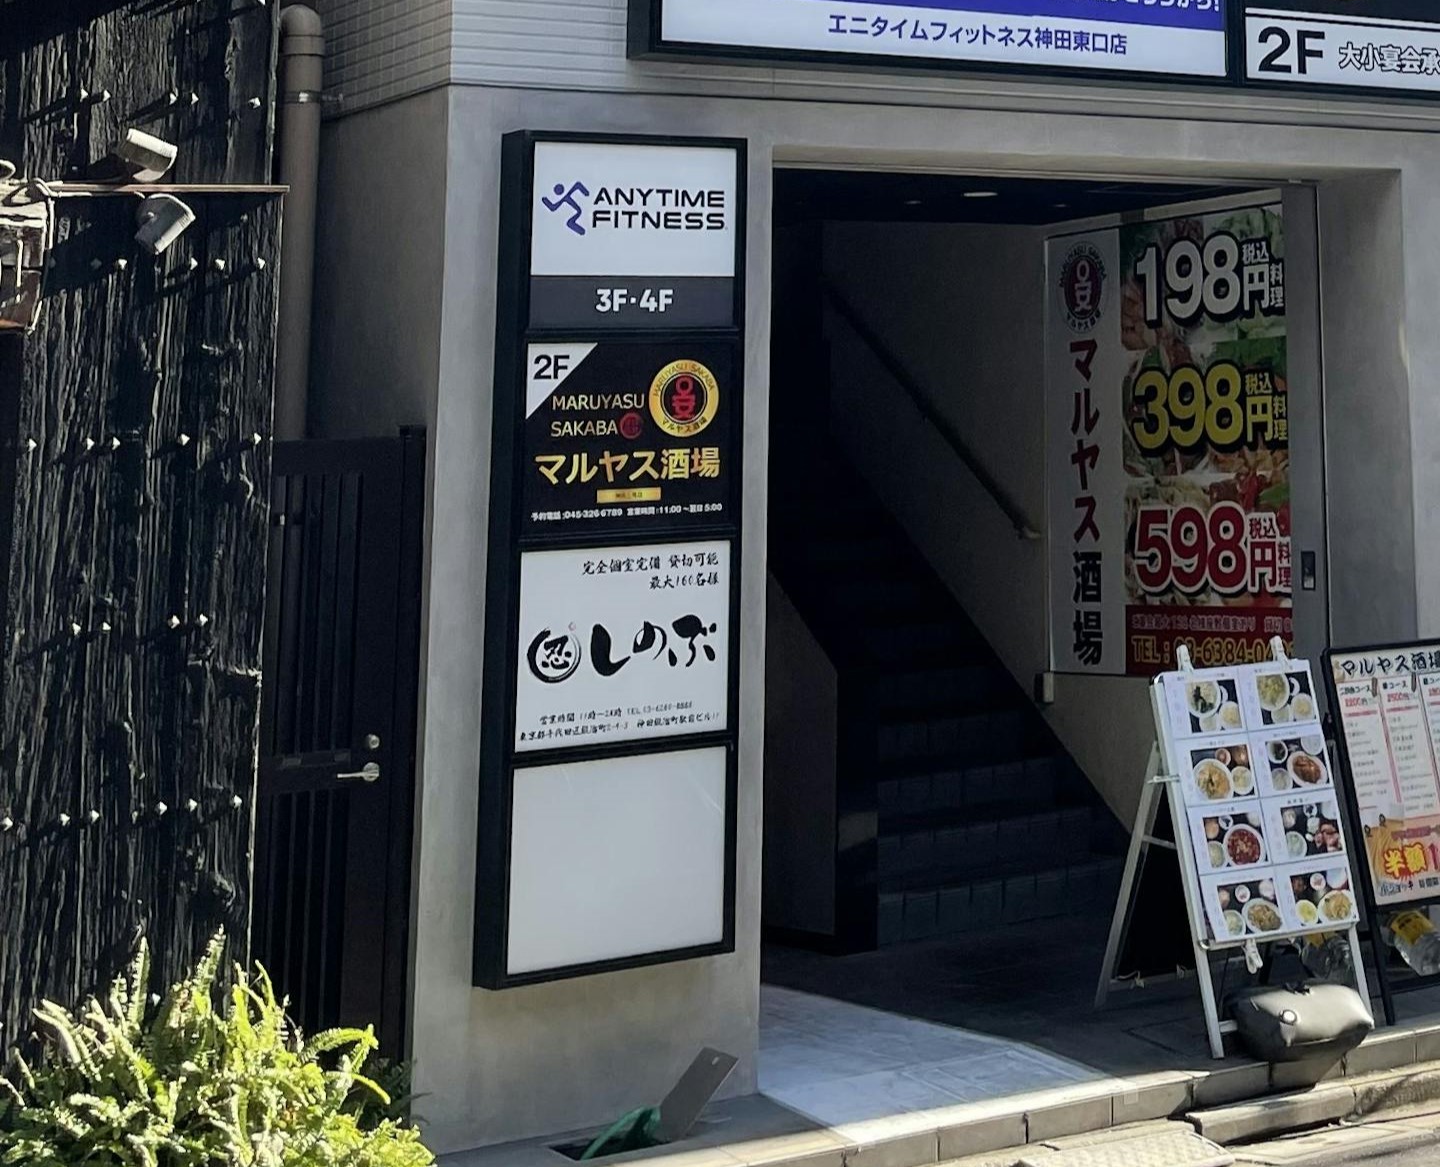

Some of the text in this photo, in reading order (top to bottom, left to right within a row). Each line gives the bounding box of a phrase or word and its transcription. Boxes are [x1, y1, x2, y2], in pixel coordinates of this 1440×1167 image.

[827, 13, 1129, 56] エニタイムフィットネス神田東口店
[1258, 25, 1326, 75] 2F
[592, 186, 726, 208] ANYTIME
[591, 210, 726, 231] FITNESS
[532, 354, 571, 381] 2F
[551, 393, 646, 411] MARUYASU
[550, 419, 619, 438] SAKABA
[534, 445, 721, 486] マルヤス酒場
[1069, 337, 1104, 667] マルヤス酒場
[589, 613, 718, 677] しのぶ
